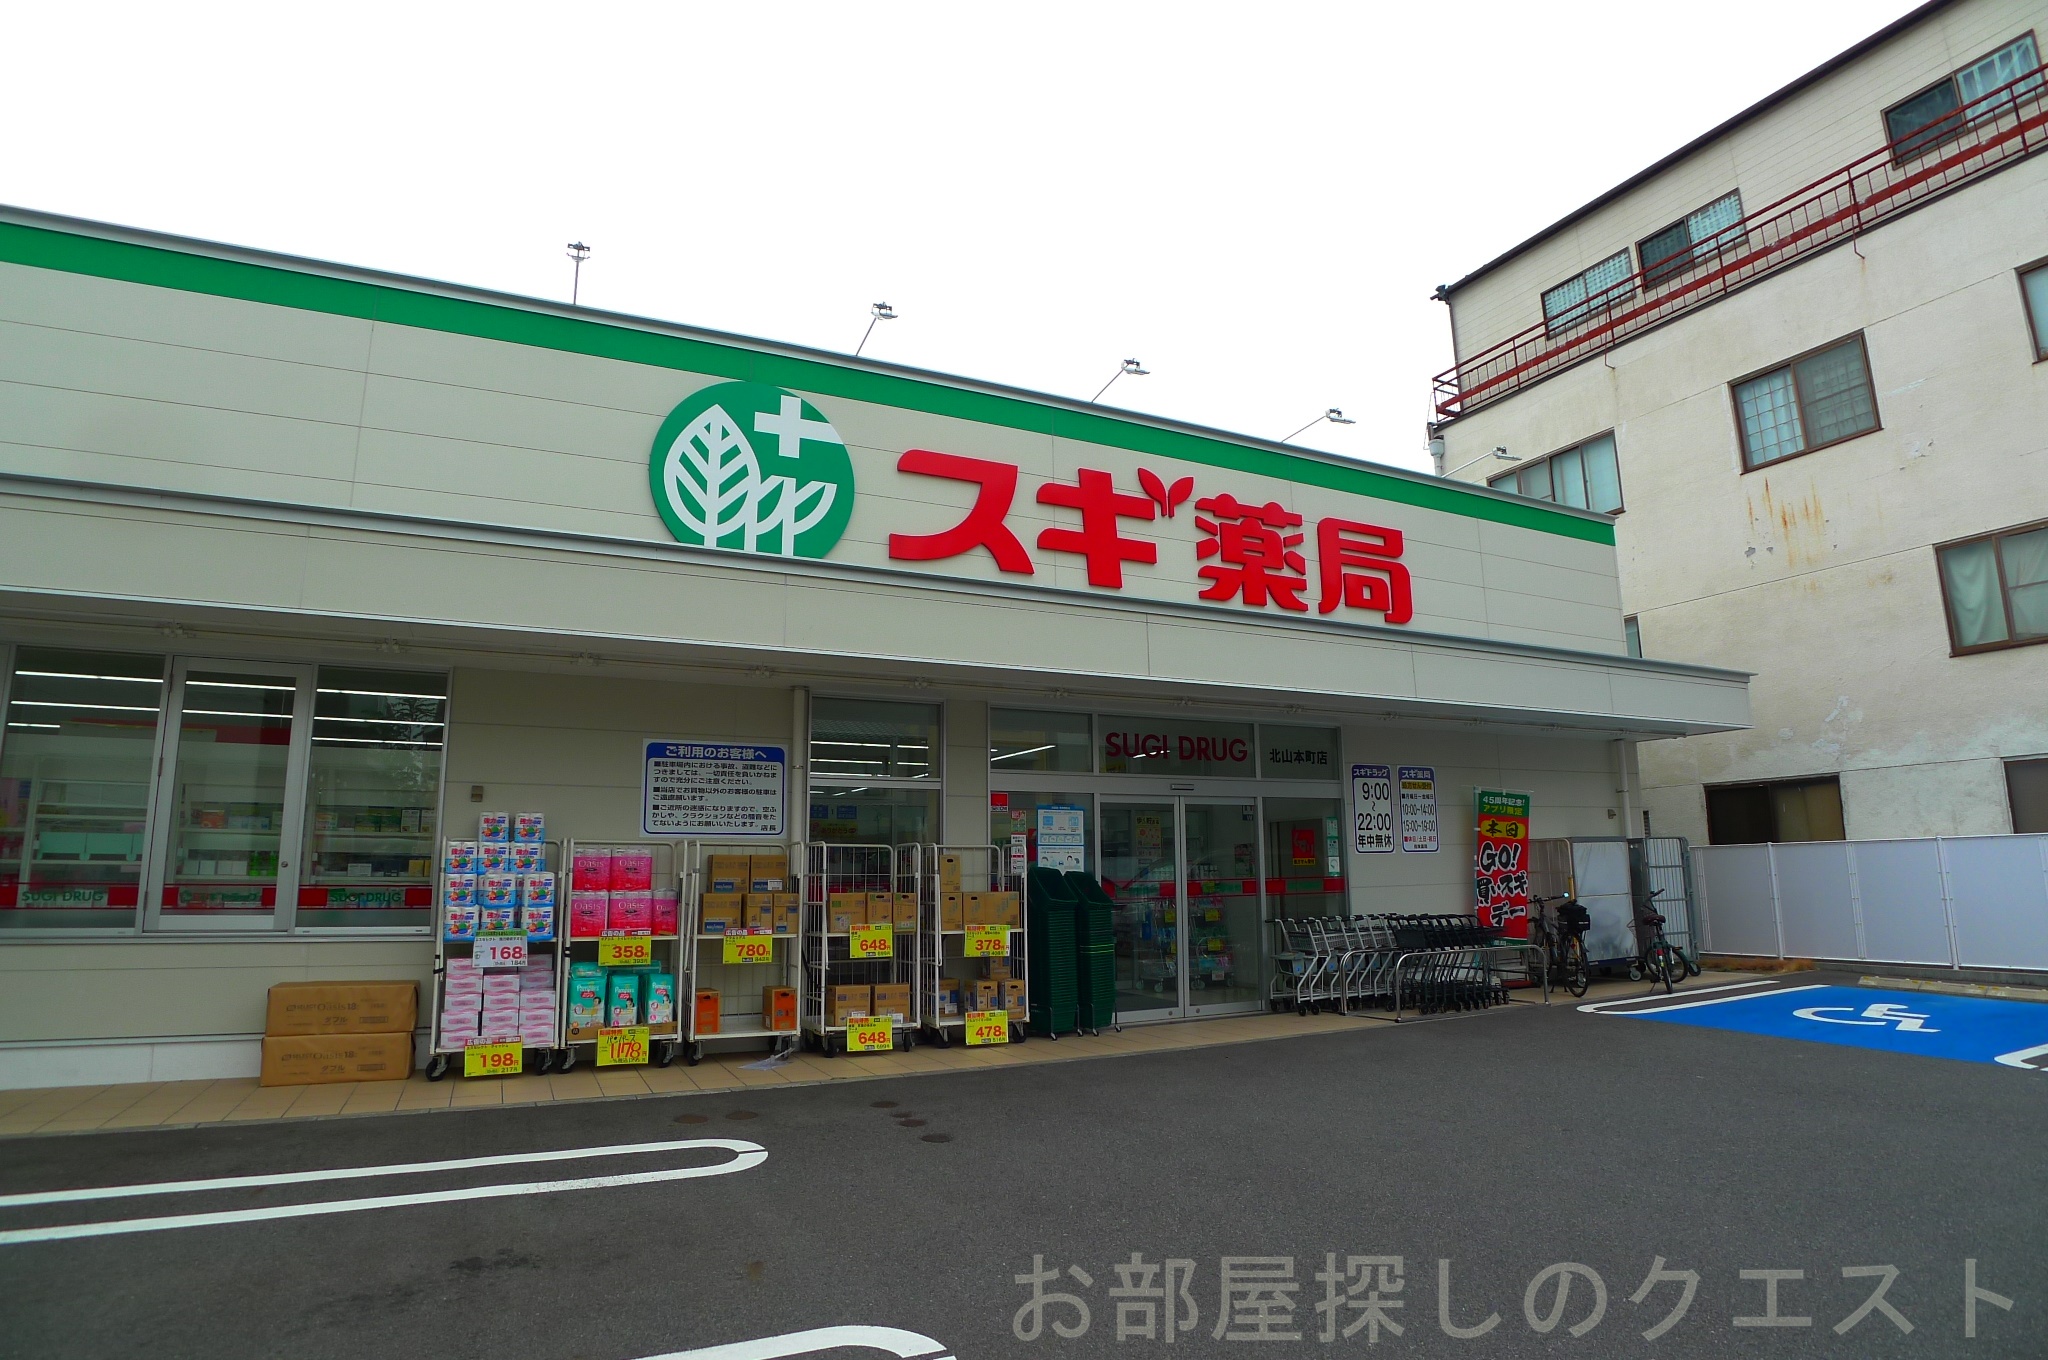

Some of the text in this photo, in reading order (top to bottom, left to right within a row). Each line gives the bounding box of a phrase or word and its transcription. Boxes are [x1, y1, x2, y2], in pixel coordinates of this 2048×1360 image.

[888, 449, 1413, 624] スギ薬局
[665, 745, 767, 759] ご利用のお客様へ
[1106, 732, 1248, 762] SUGI DRUG
[1269, 748, 1328, 765] 北山本町店
[1353, 768, 1389, 777] スギドラッグ
[1402, 770, 1431, 779] スギ薬局
[1362, 782, 1390, 800] 9:00
[1483, 804, 1523, 816] アプリ限定
[1357, 813, 1391, 831] 22:00
[1485, 819, 1519, 838] 本日
[1358, 834, 1392, 848] 年中無休
[1480, 842, 1520, 873] GO!
[63, 891, 104, 902] DRUG
[1477, 872, 1527, 906] 買いスギ
[1491, 902, 1526, 927] デー
